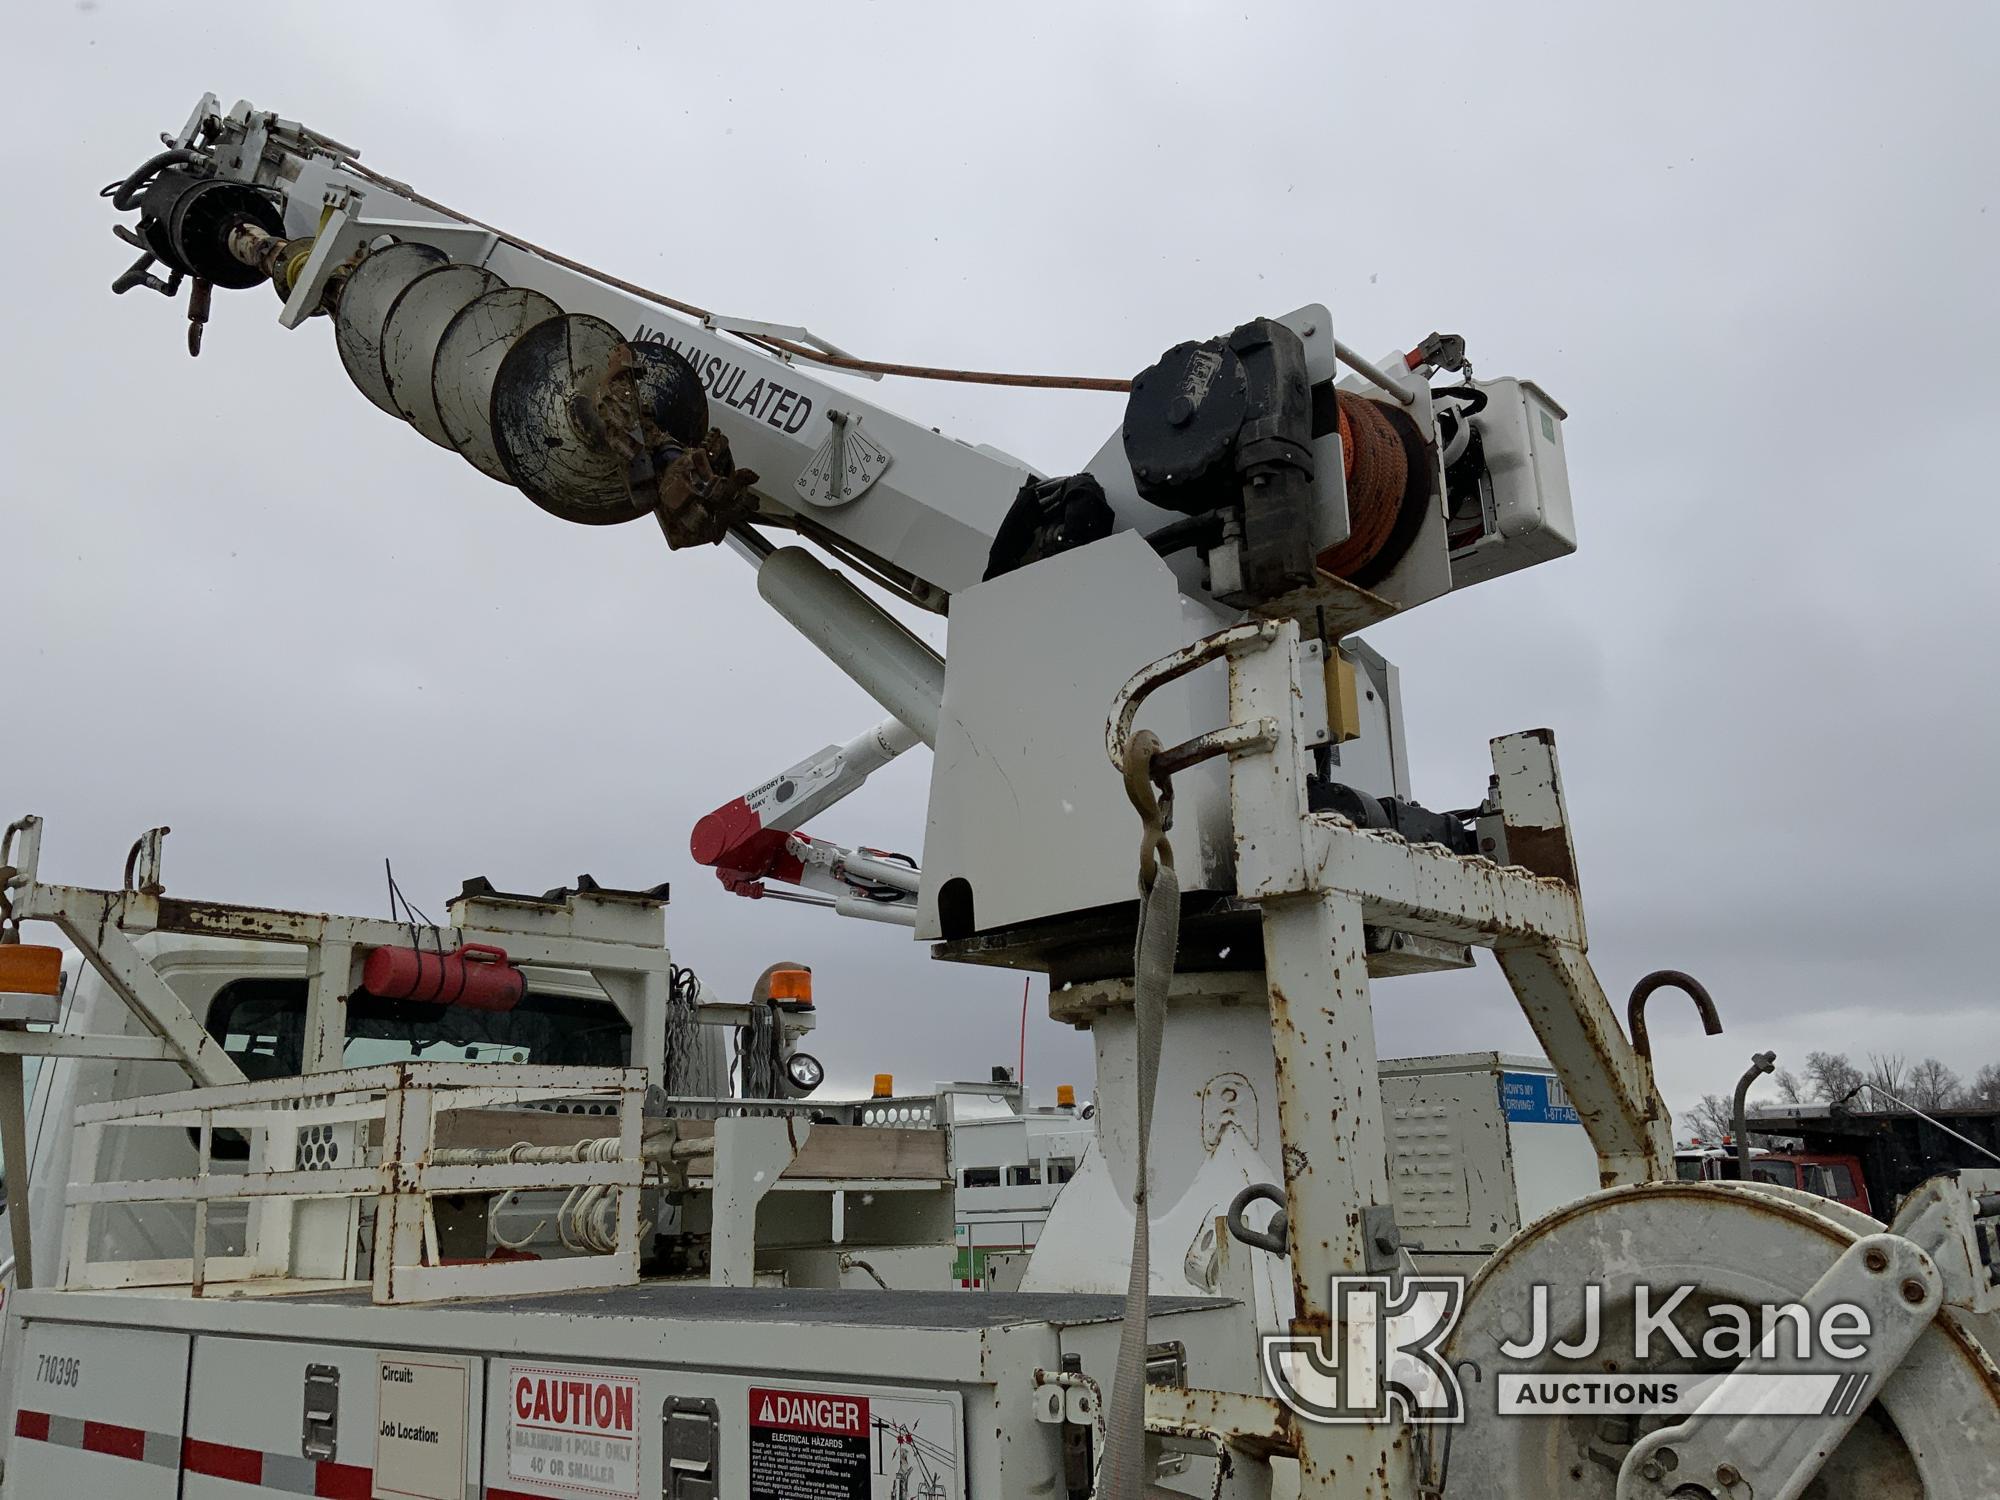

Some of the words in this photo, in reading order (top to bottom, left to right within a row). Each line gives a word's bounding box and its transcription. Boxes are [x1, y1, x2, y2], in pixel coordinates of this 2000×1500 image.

[863, 453, 871, 463] 70
[876, 454, 886, 464] 80
[822, 473, 830, 481] 10
[848, 465, 857, 474] 50
[862, 473, 871, 483] 60
[810, 488, 815, 496] 0
[843, 486, 852, 496] 40
[746, 778, 779, 801] CATEGORY
[1506, 1098, 1535, 1110] DRIVING?
[1543, 1107, 1578, 1121] 1-877-AE
[36, 1354, 80, 1388] 710396
[382, 1365, 413, 1383] Circuit:
[516, 1376, 633, 1431] CAUTION
[777, 1396, 860, 1430] DANGER
[380, 1420, 395, 1437] Job
[398, 1422, 439, 1444] Location:
[515, 1431, 562, 1452] MAXIMUM
[575, 1439, 601, 1457] POLE
[605, 1442, 632, 1462] ONLY
[771, 1433, 810, 1445] ELECTRICAL
[811, 1437, 843, 1449] HAZARDS
[550, 1459, 564, 1476] OR
[568, 1462, 615, 1484] SMALLER
